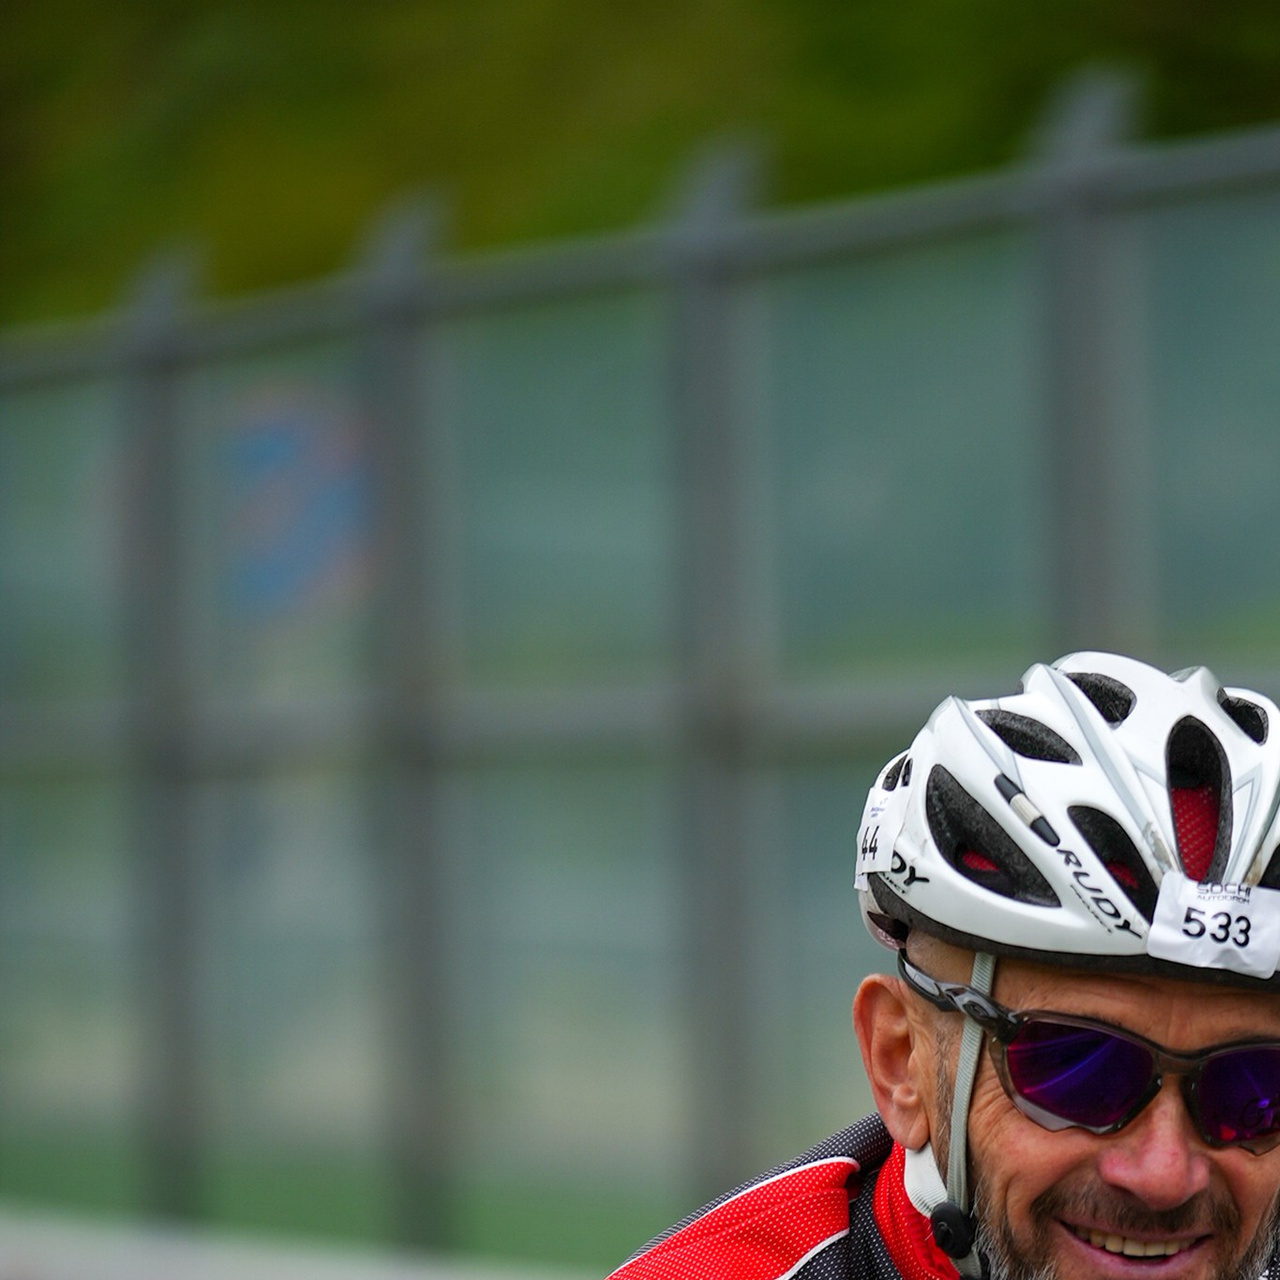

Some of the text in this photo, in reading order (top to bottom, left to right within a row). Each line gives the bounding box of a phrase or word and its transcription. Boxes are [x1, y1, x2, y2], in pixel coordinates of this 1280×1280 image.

[891, 850, 930, 886] DY
[1057, 848, 1143, 940] RUDY
[1182, 906, 1252, 948] 533
